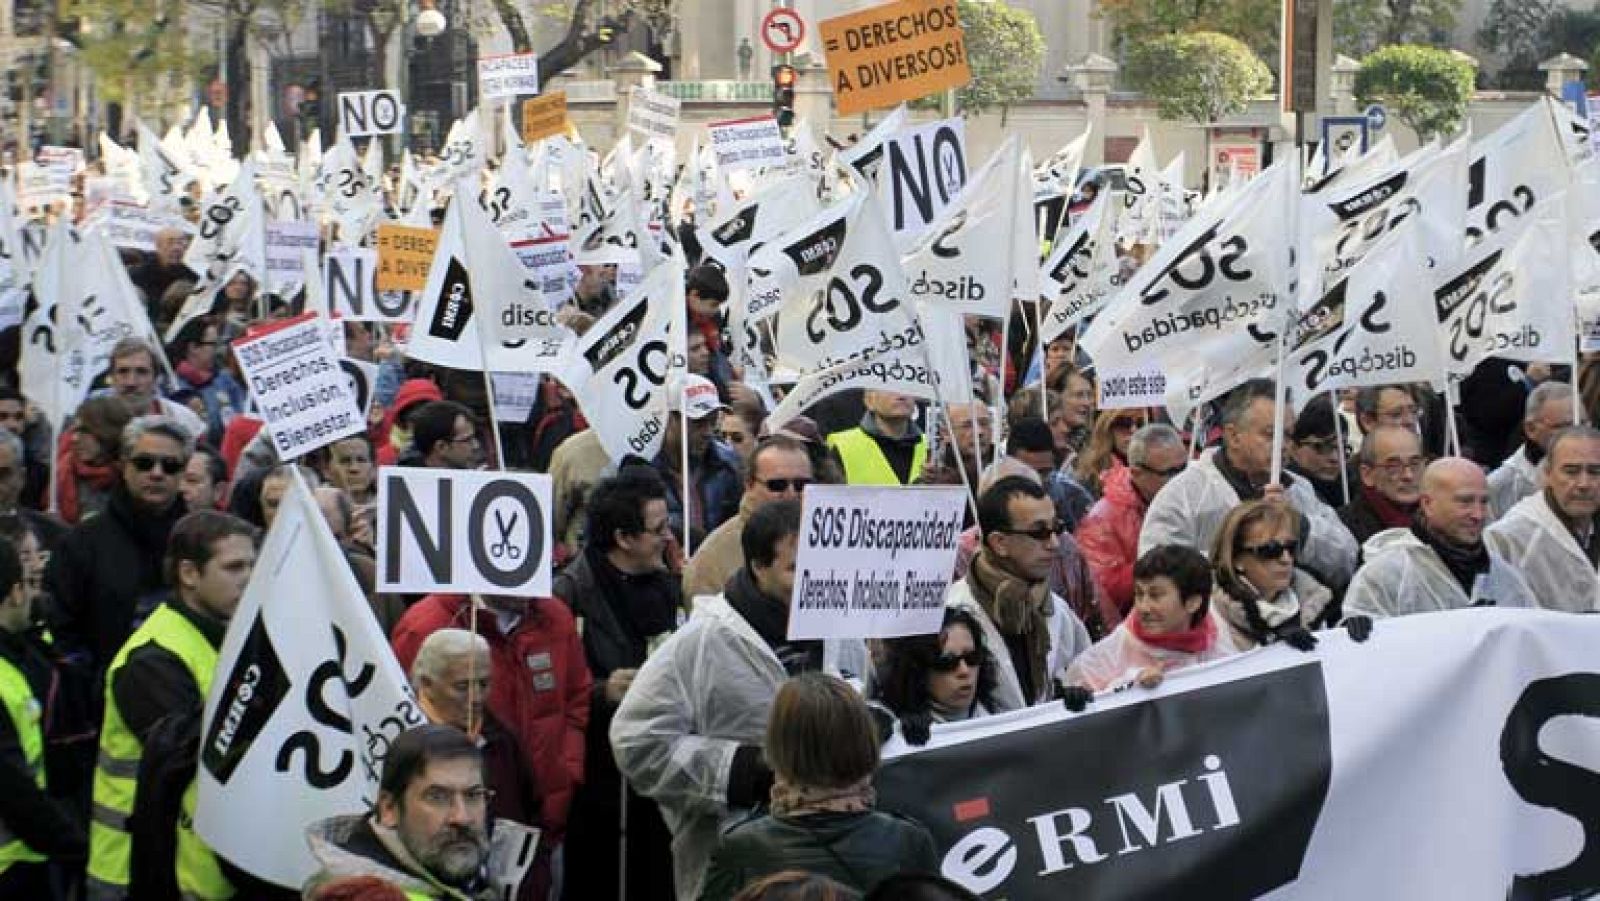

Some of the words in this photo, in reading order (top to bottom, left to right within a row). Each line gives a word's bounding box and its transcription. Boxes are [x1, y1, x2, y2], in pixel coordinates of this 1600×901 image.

[845, 4, 956, 54] DERECHOS
[836, 71, 853, 94] A
[857, 42, 964, 86] DIVERSOS!
[342, 93, 399, 133] NO
[887, 126, 966, 231] NO
[384, 475, 545, 588] NO
[809, 506, 847, 549] SOS
